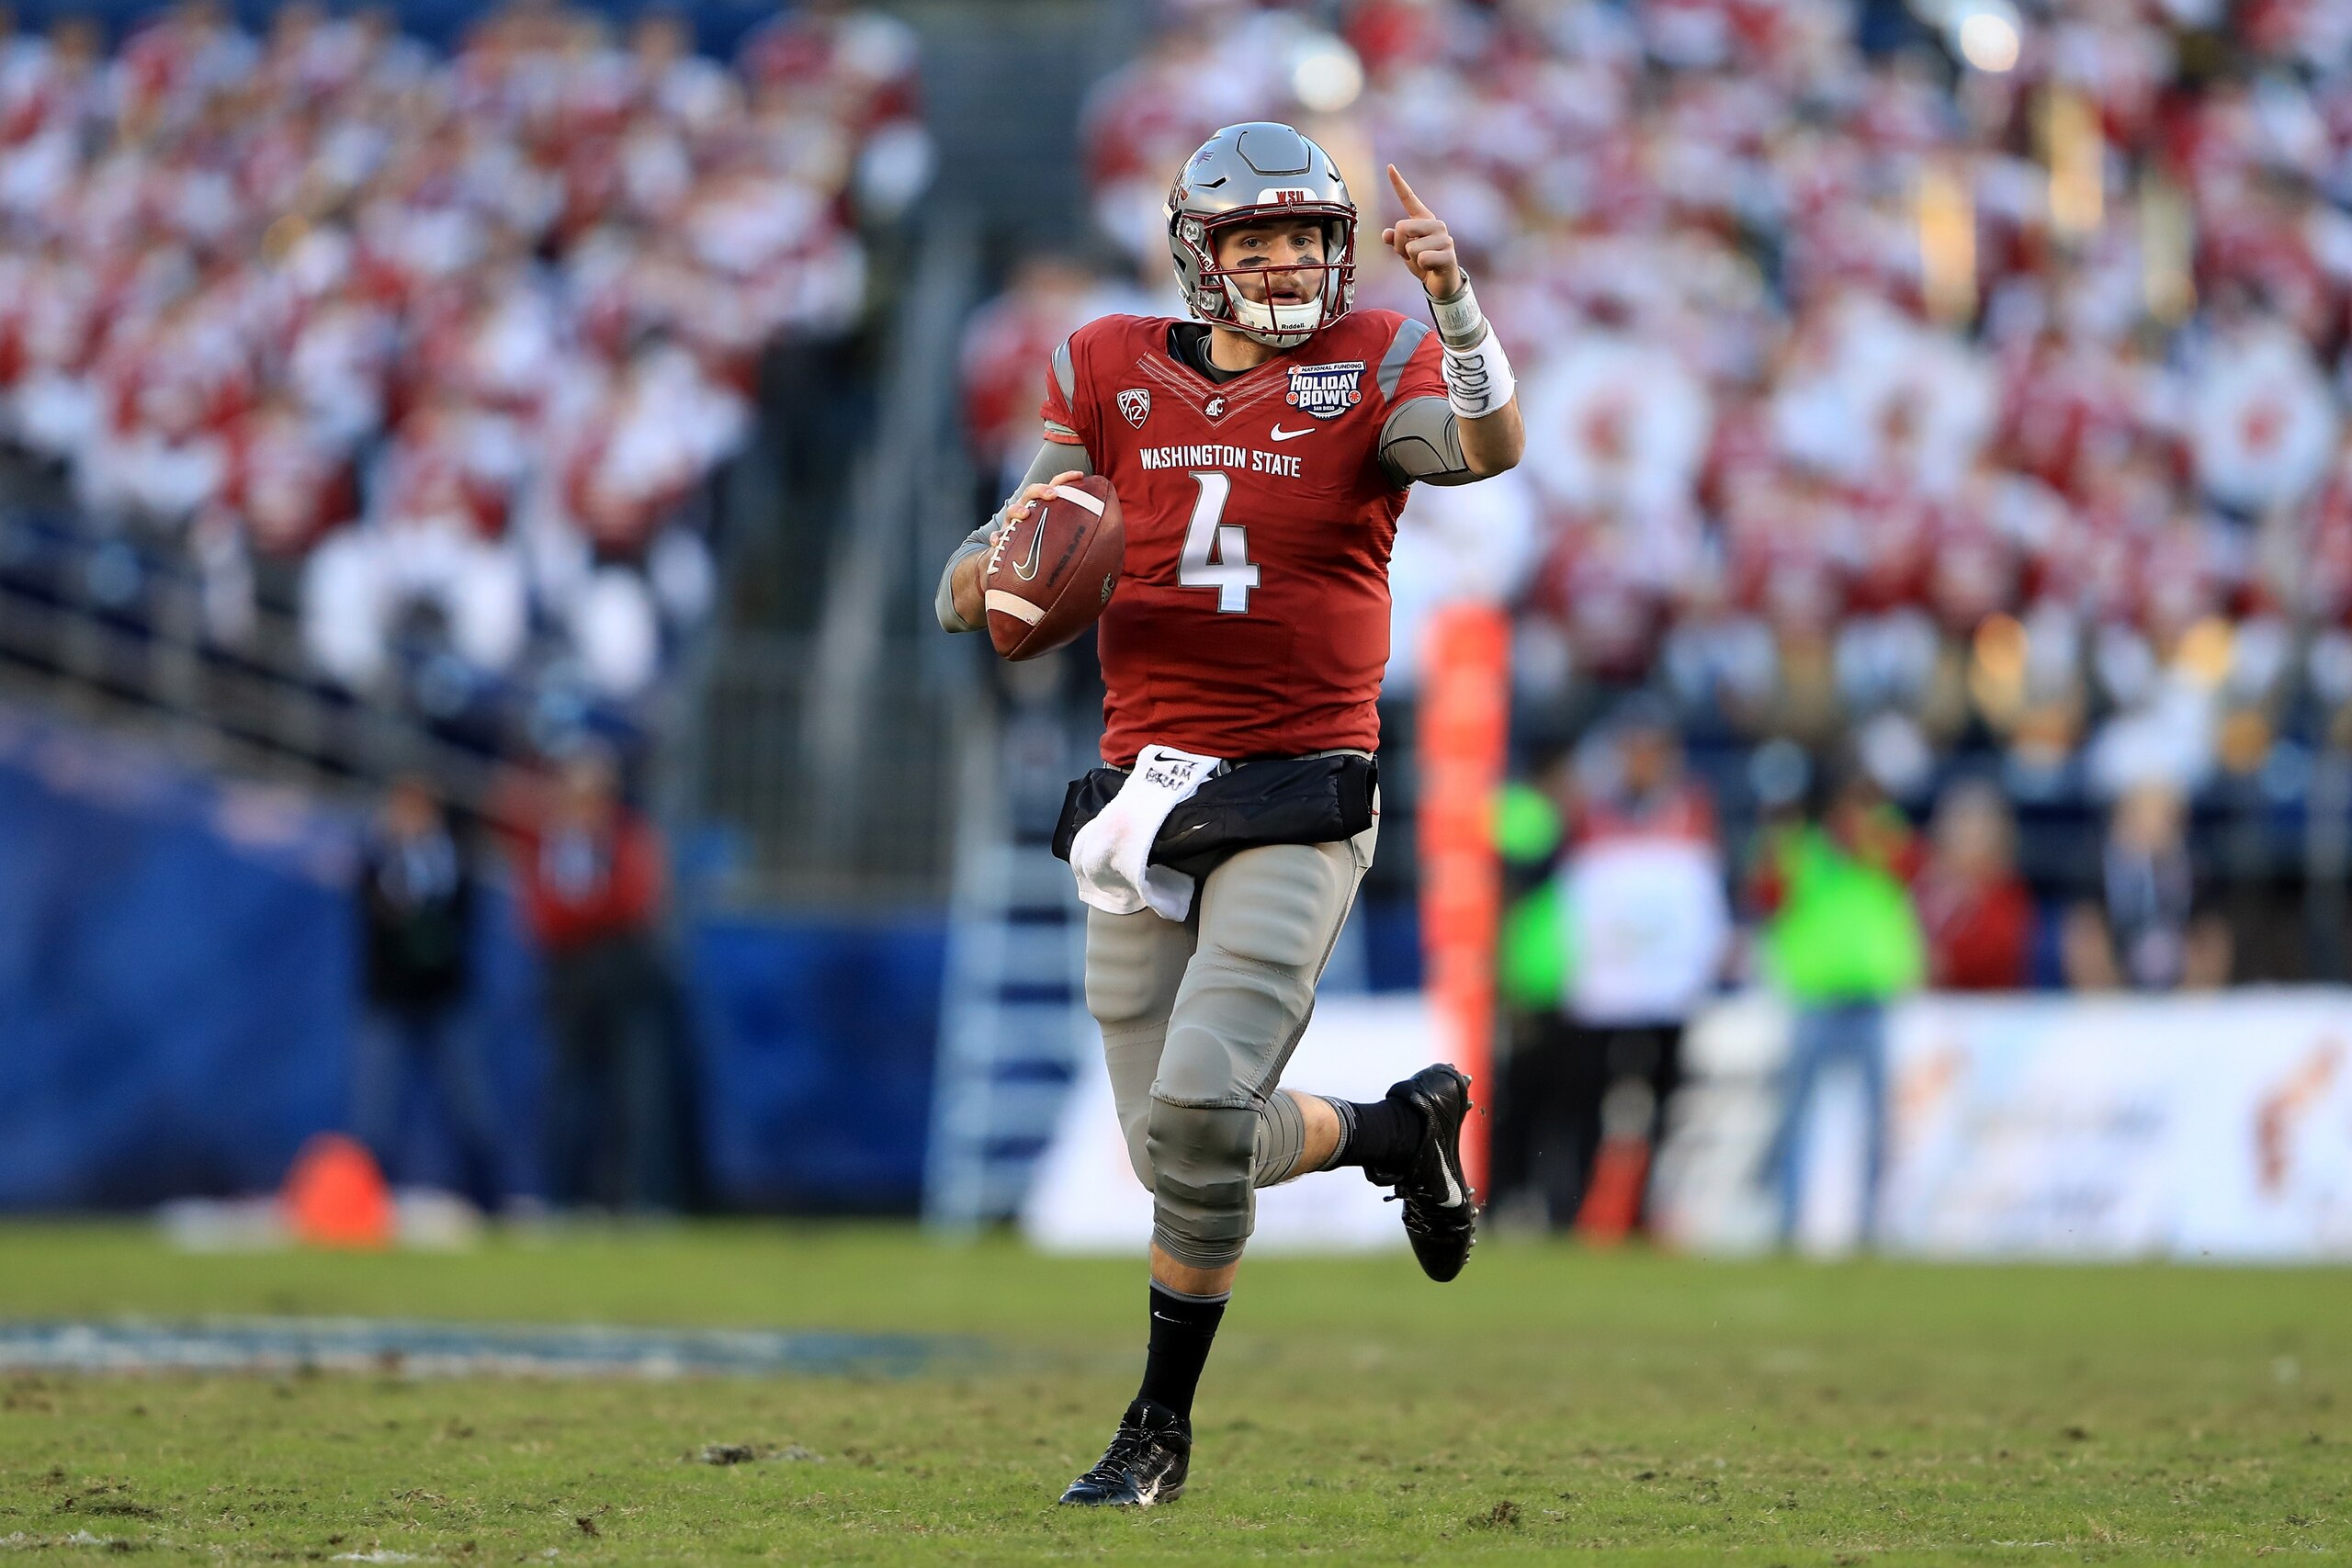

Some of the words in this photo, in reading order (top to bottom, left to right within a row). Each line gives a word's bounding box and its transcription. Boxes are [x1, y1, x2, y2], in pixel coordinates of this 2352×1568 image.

[1276, 191, 1305, 203] WSU
[1290, 371, 1359, 391] HOLIDAY
[1120, 390, 1148, 414] PAC
[1299, 389, 1351, 409] BOWL
[1128, 406, 1144, 422] 12
[1140, 446, 1246, 469] WASHINGTON
[1251, 450, 1302, 478] STATE
[1176, 470, 1261, 614] 4
